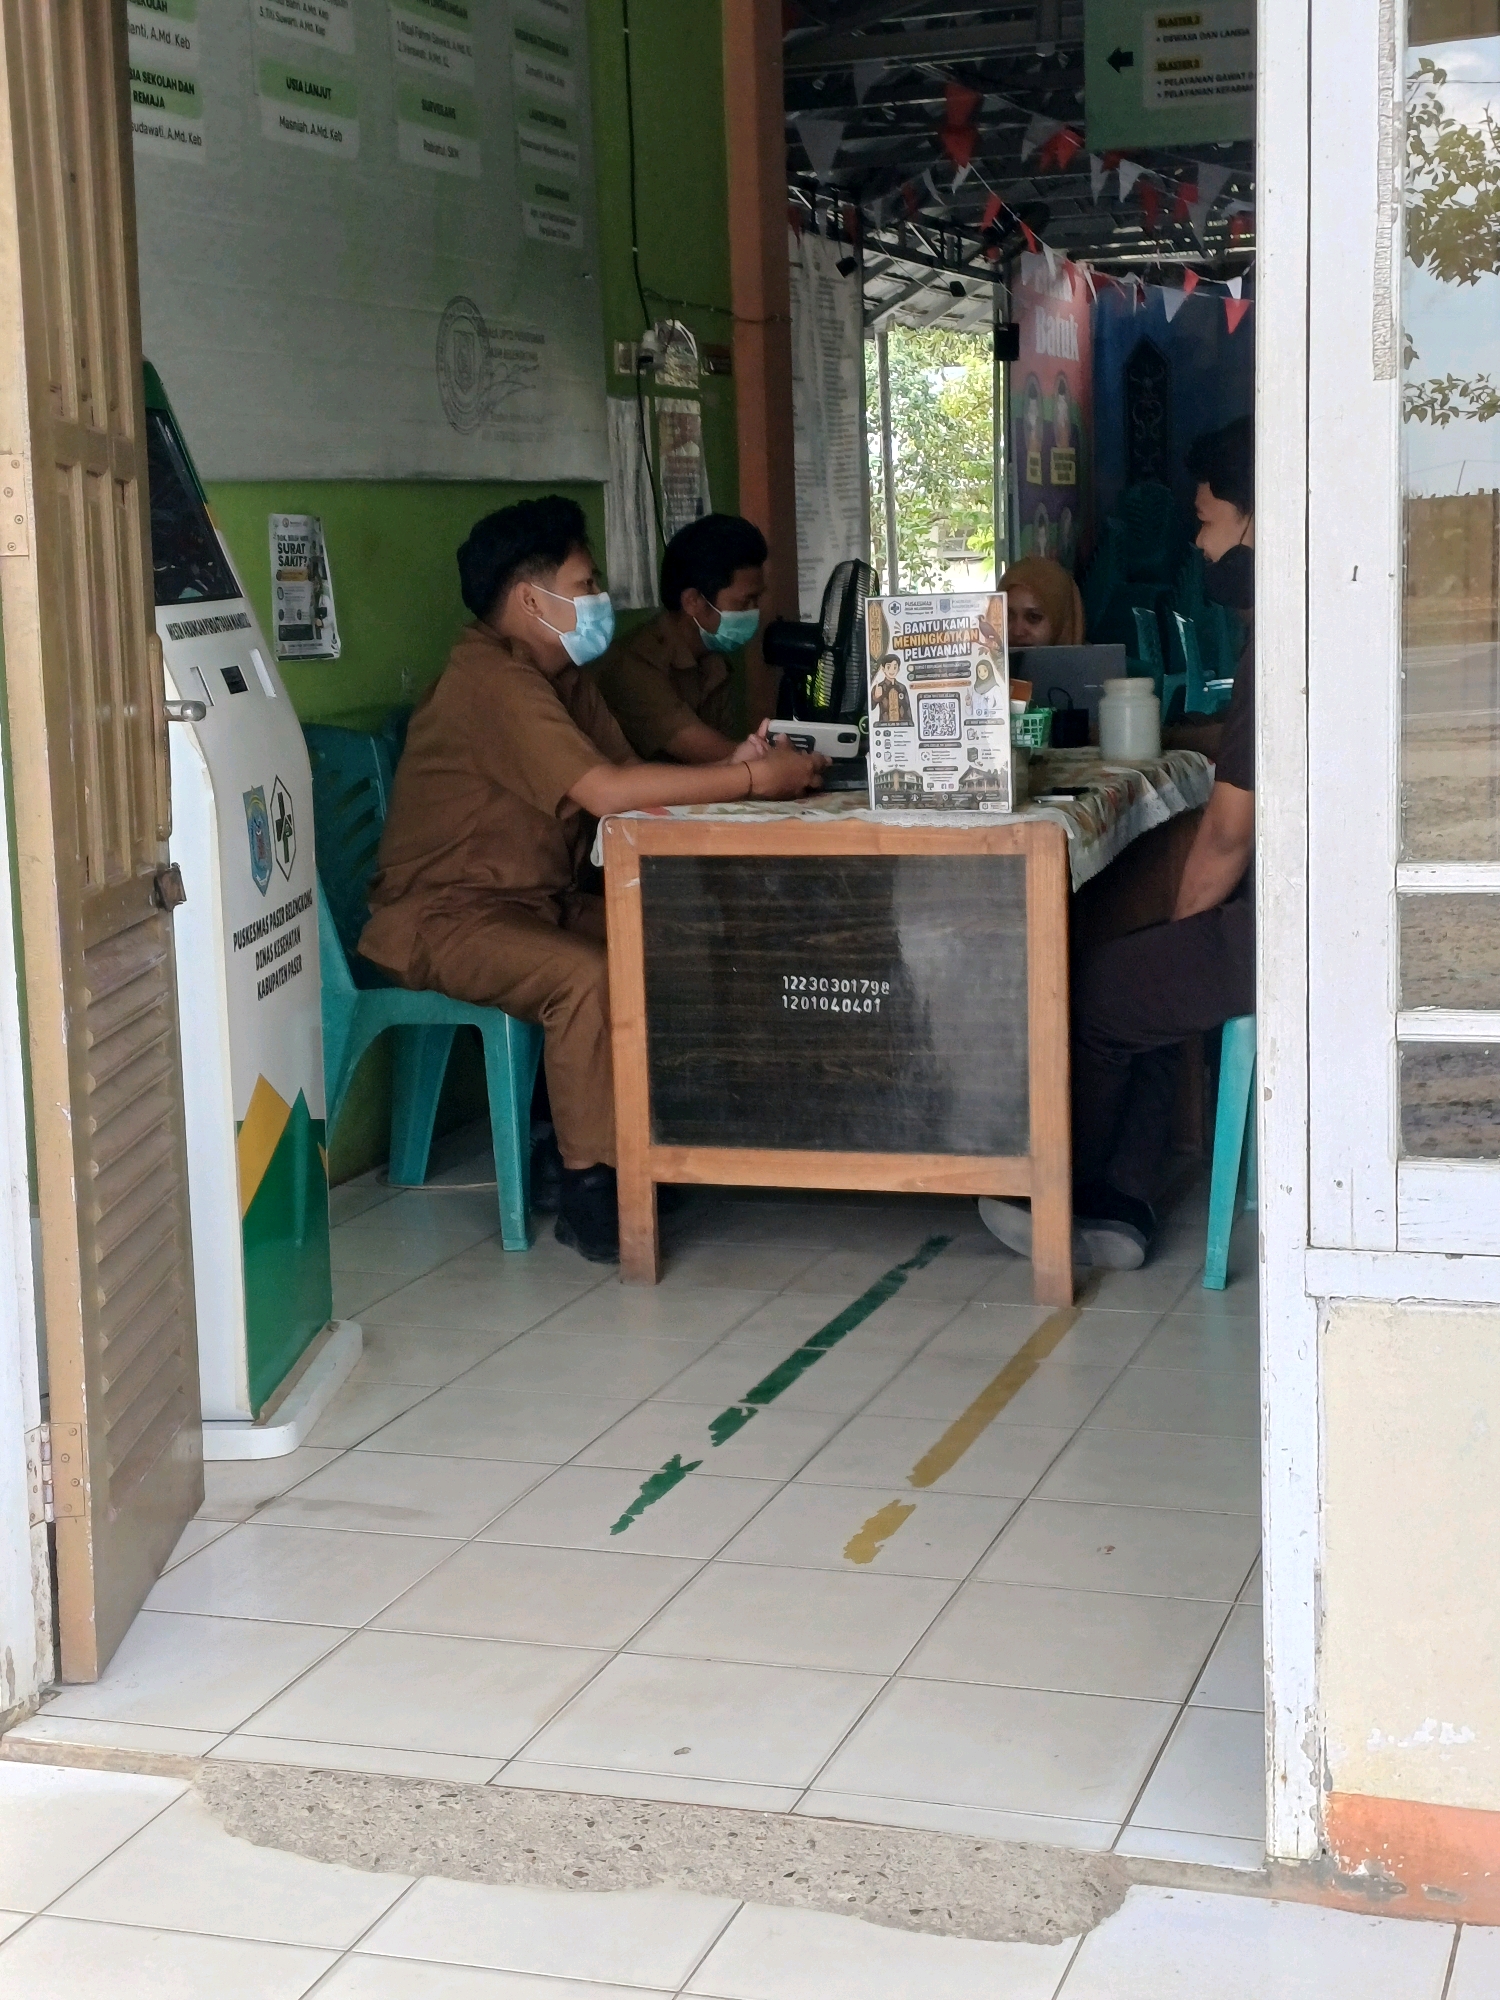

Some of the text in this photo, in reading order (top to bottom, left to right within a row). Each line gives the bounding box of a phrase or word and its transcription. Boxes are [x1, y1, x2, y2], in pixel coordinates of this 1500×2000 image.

[175, 33, 191, 50] Keb
[142, 71, 177, 90] SEKOLAH
[178, 80, 195, 95] DAN
[286, 77, 331, 100] USIA LANJUT
[133, 90, 165, 109] REMAJA
[188, 132, 202, 146] Keb
[330, 129, 342, 142] Keb
[278, 541, 305, 554] SURAT
[279, 555, 308, 567] SAKIT?
[904, 617, 969, 634] BANTU KAMI
[893, 628, 979, 649] MENINGKATKAN
[904, 644, 971, 660] PELAYANAN!
[233, 914, 269, 952] PUSKESMAS
[255, 924, 301, 971] DINAS KESEHATAN
[257, 964, 287, 1001] KABUPATEN
[782, 975, 890, 996] 12230301798
[782, 994, 881, 1013] 1201040401
